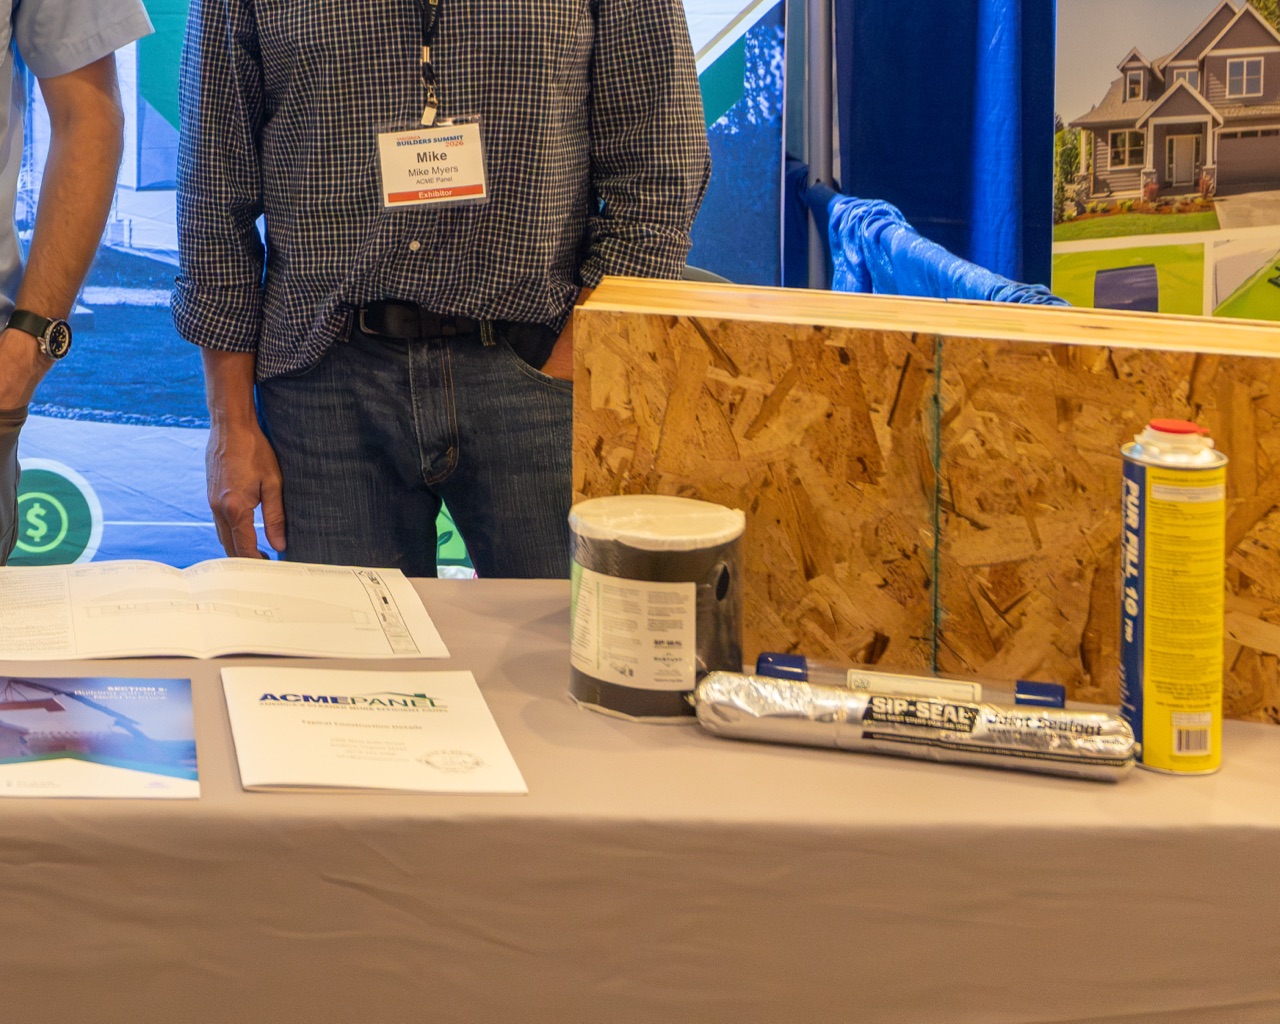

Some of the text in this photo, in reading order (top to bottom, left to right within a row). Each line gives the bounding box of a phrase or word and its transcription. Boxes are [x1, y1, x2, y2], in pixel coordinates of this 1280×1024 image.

[396, 135, 464, 147] BUILDERS SUMMIT
[416, 151, 448, 163] Mike
[408, 166, 459, 177] Mike Myers
[418, 189, 453, 199] Exhibitor
[1125, 478, 1140, 528] PUR
[1124, 533, 1139, 579] FILL
[1124, 584, 1139, 616] 10
[258, 692, 448, 709] ACMEPANEL
[871, 696, 972, 725] SIP-SEAL
